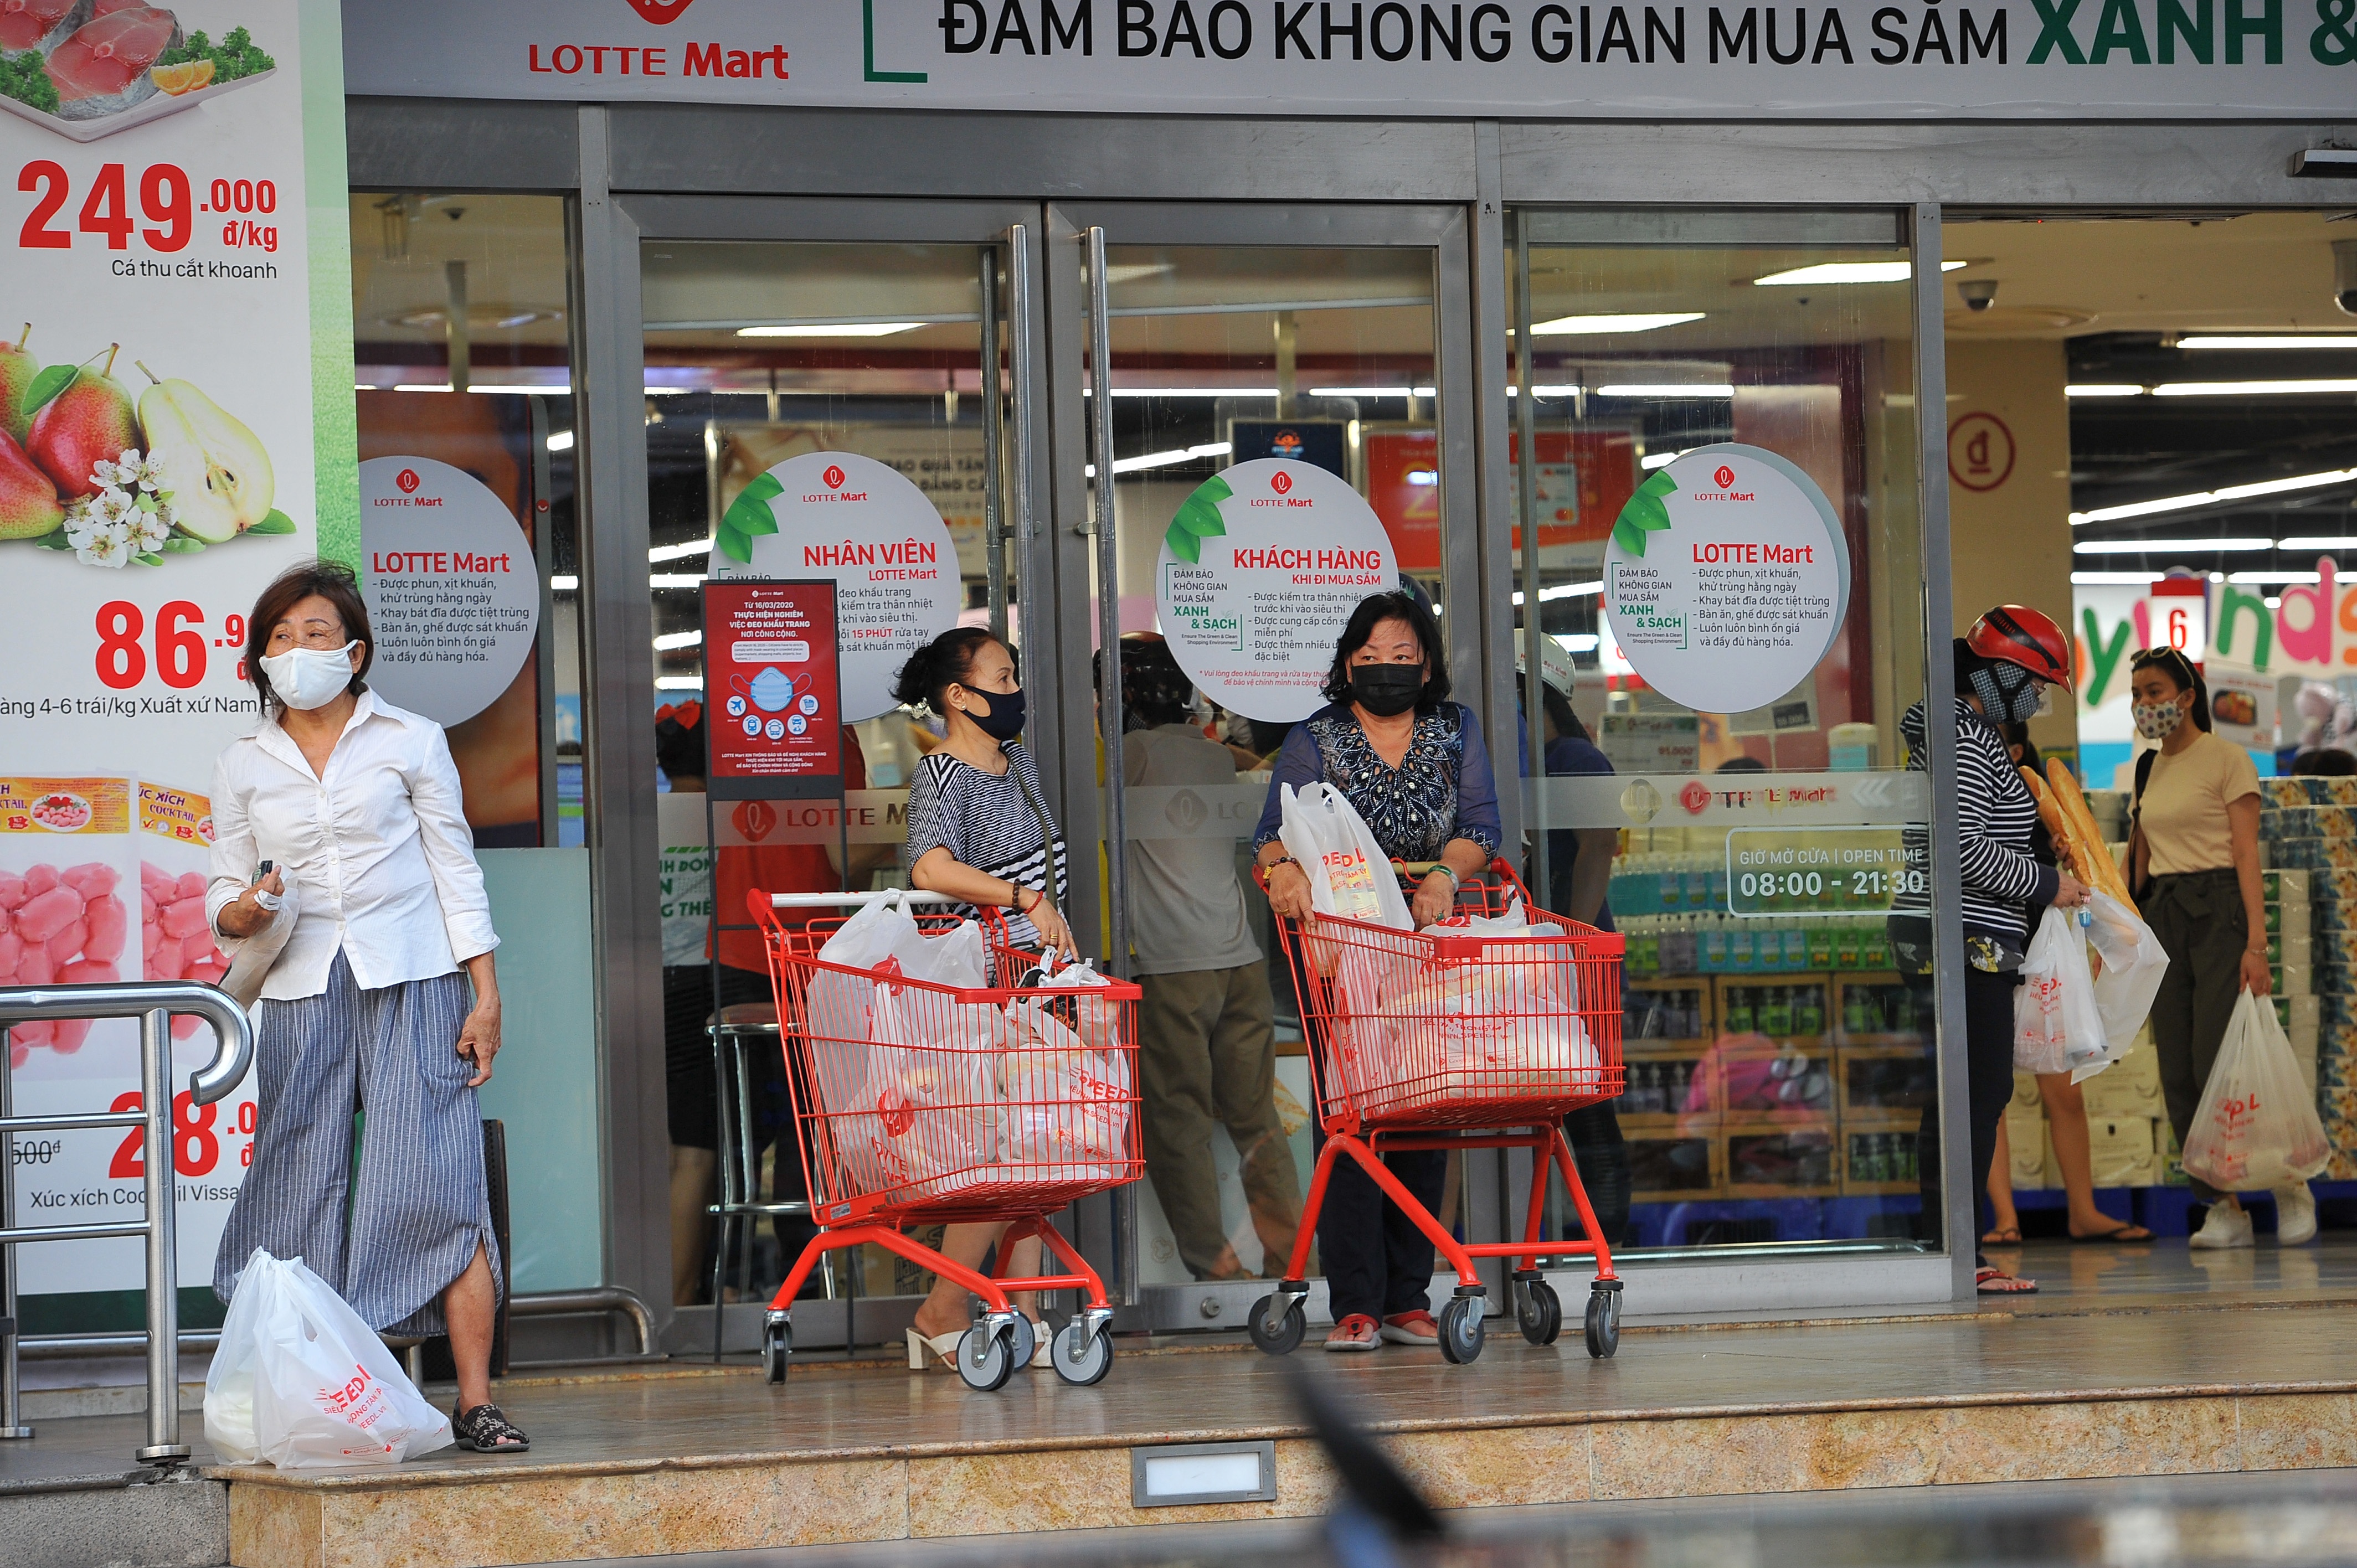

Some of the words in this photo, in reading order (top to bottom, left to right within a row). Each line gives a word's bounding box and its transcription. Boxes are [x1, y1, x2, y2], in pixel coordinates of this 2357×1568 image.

[1531, 4, 1685, 64] GIAN
[1708, 7, 1854, 65] MUA
[2025, 0, 2283, 65] XANH
[529, 44, 666, 76] LOTTE
[683, 42, 789, 80] Mart
[112, 259, 135, 276] Cá
[140, 259, 171, 277] thu
[176, 258, 204, 277] cắt
[208, 261, 277, 278] khoanh
[374, 498, 410, 507] LOTTE
[414, 497, 443, 507] Mart
[1730, 492, 1754, 501] Mart
[804, 539, 874, 567] NHÂN
[879, 537, 936, 564] VIÊN
[1234, 544, 1311, 569] KHÁCH
[1318, 545, 1381, 570] HÀNG
[1693, 543, 1758, 563] LOTTE
[1763, 544, 1813, 564] Mart
[373, 551, 447, 573] LOTTE
[453, 552, 510, 573] Mart
[869, 569, 906, 581] LOTTE
[908, 568, 938, 580] Mart
[1292, 574, 1311, 585] KHI
[1314, 574, 1325, 585] ĐI
[1328, 574, 1354, 585] MUA
[1356, 570, 1381, 585] SẮM
[1619, 567, 1639, 577] ĐẢM
[1640, 567, 1658, 577] BẢO
[380, 579, 409, 591] Được
[411, 578, 442, 590] phun,
[444, 577, 458, 590] xịt
[460, 577, 497, 590] khuẩn,
[1619, 579, 1650, 590] KHÔNG
[1651, 581, 1672, 590] GIAN
[380, 592, 402, 603] khử
[404, 592, 434, 605] trùng
[466, 592, 492, 605] ngày
[838, 589, 857, 598] đeo
[859, 586, 883, 597] khẩu
[884, 588, 911, 598] trang
[1254, 592, 1277, 603] Được
[1279, 591, 1301, 601] kiểm
[1303, 593, 1315, 601] tra
[1317, 592, 1337, 601] thân
[1619, 593, 1639, 601] MUA
[1640, 590, 1659, 602] SẮM
[841, 600, 865, 611] kiểm
[867, 601, 881, 610] tra
[883, 599, 905, 610] thân
[908, 598, 933, 610] nhiệt
[1254, 603, 1278, 613] trước
[1280, 604, 1294, 613] khi
[1295, 604, 1311, 613] vào
[1313, 604, 1331, 613] siêu
[1619, 605, 1654, 615] XANH
[380, 607, 408, 620] Khay
[410, 606, 428, 618] bát
[430, 607, 447, 617] đĩa
[449, 607, 477, 620] được
[479, 606, 498, 620] tiệt
[500, 606, 529, 620] trùng
[842, 613, 857, 623] khi
[860, 613, 877, 623] vào
[879, 612, 899, 622] siêu
[901, 611, 918, 623] thị.
[1699, 608, 1717, 618] Bàn
[1720, 609, 1734, 621] ăn,
[1736, 608, 1754, 621] ghế
[1756, 609, 1780, 621] được
[1782, 608, 1797, 619] sát
[1799, 608, 1829, 619] khuẩn
[1254, 616, 1278, 627] Được
[1279, 618, 1301, 627] cung
[1303, 615, 1320, 627] cấp
[1636, 617, 1645, 628] &
[1648, 617, 1681, 631] SẠCH
[852, 629, 863, 638] 15
[866, 627, 893, 638] PHÚT
[895, 627, 912, 637] rửa
[913, 628, 929, 637] tay
[1254, 627, 1277, 637] miễn
[1278, 627, 1294, 639] phí
[1700, 622, 1723, 632] Luôn
[1725, 622, 1746, 633] luôn
[1748, 622, 1769, 633] bình
[1771, 622, 1783, 633] ổn
[1785, 622, 1800, 635] giá
[2169, 608, 2187, 649] 6
[846, 641, 862, 652] sát
[863, 639, 894, 651] khuẩn
[896, 639, 915, 652] một
[1254, 640, 1278, 651] Được
[1280, 639, 1303, 649] thêm
[1305, 639, 1330, 649] nhiều
[1700, 636, 1711, 646] và
[1713, 636, 1731, 648] đầy
[1732, 636, 1744, 646] đủ
[1747, 636, 1771, 648] hàng
[1773, 636, 1793, 646] hóa.
[1254, 652, 1271, 662] đặc
[1273, 651, 1290, 663] biệt
[39, 698, 72, 714] 4-6
[75, 696, 136, 718] trái/kg
[140, 694, 183, 714] Xuất
[187, 695, 211, 713] xứ
[215, 697, 257, 713] Nam
[155, 791, 186, 806] XÍCH
[149, 804, 195, 823] COCKTAIL
[1740, 848, 1766, 865] GIỜ
[1770, 847, 1794, 864] MỞ
[1798, 847, 1829, 864] CỬA
[1844, 849, 1883, 863] OPEN
[1887, 849, 1923, 863] TIME
[1740, 873, 1822, 897] 08:00
[1852, 870, 1924, 895] 21:30
[30, 1189, 65, 1208] Xúc
[70, 1188, 109, 1206] xích
